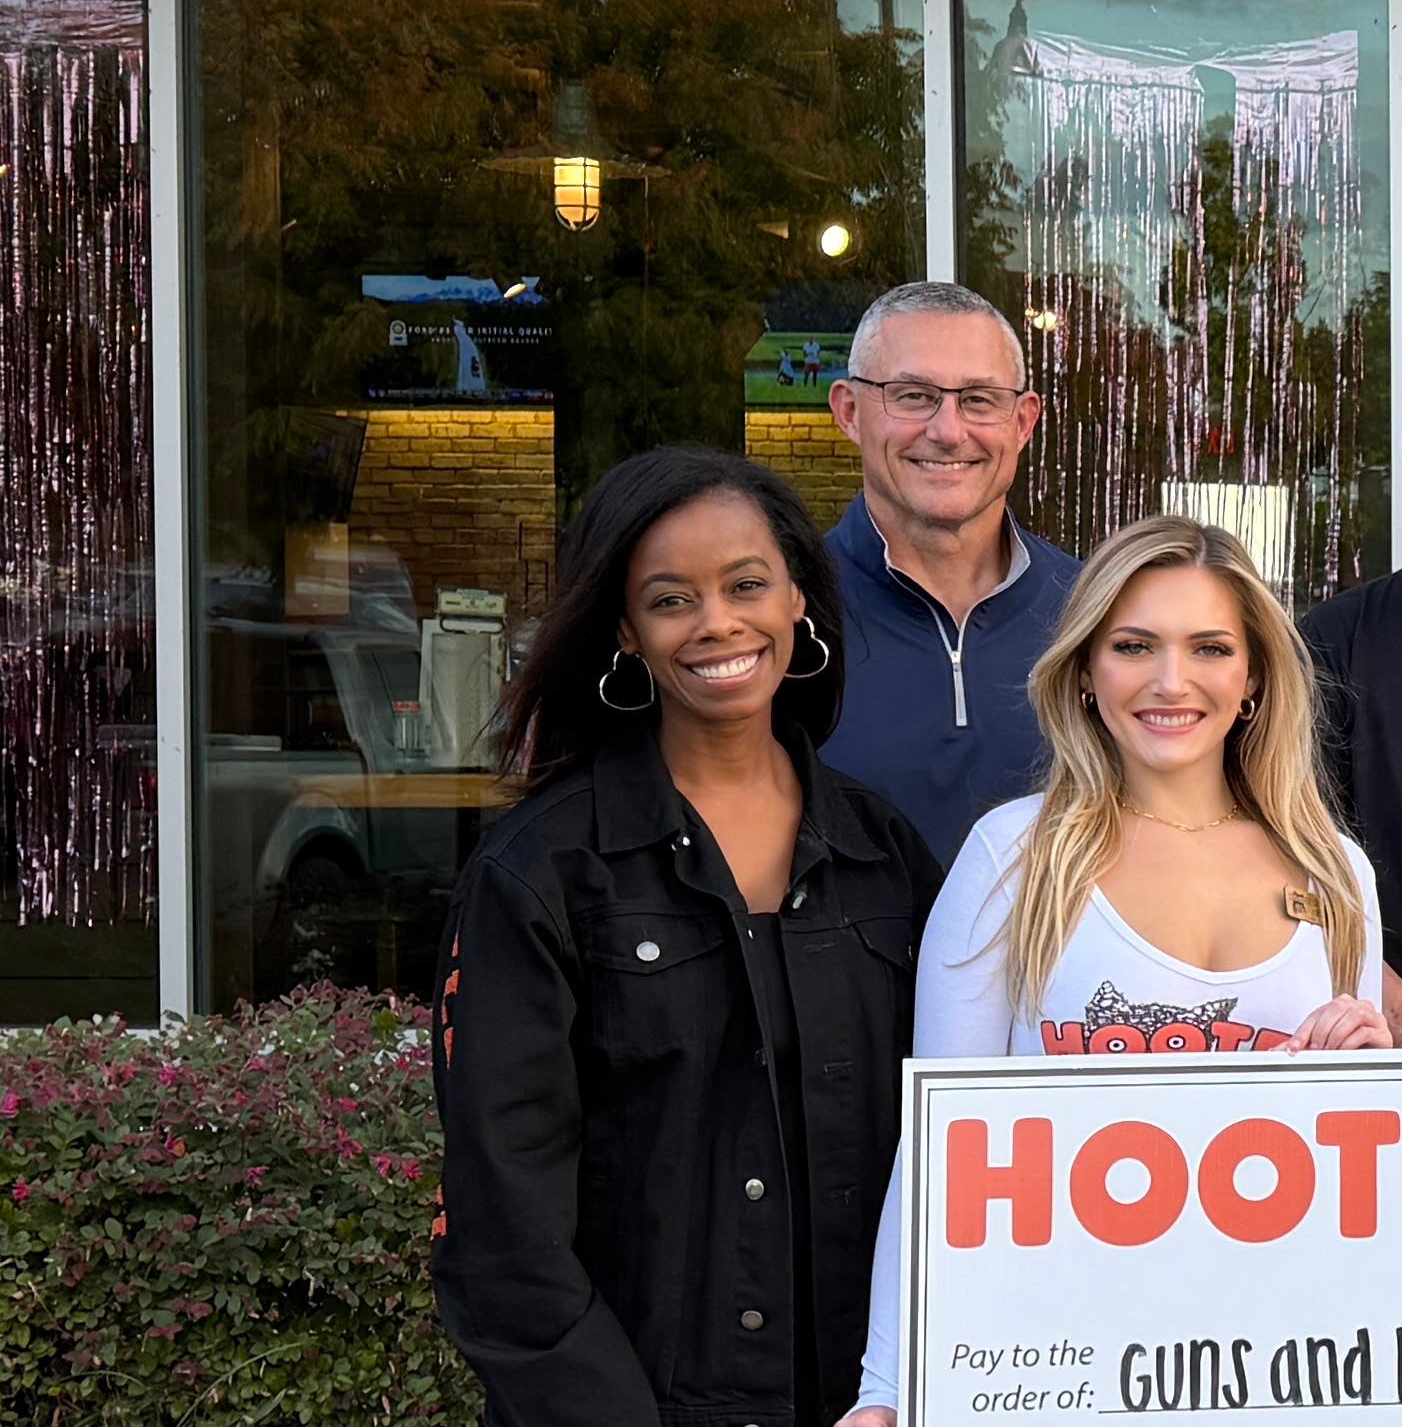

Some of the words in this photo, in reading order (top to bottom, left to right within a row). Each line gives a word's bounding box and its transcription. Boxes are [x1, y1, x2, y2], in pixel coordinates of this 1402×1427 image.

[951, 1342, 1008, 1370] Pay
[1013, 1343, 1041, 1367] to
[1048, 1339, 1095, 1366] the
[1270, 1328, 1372, 1406] and
[972, 1387, 1051, 1413] order
[1056, 1386, 1095, 1412] of:
